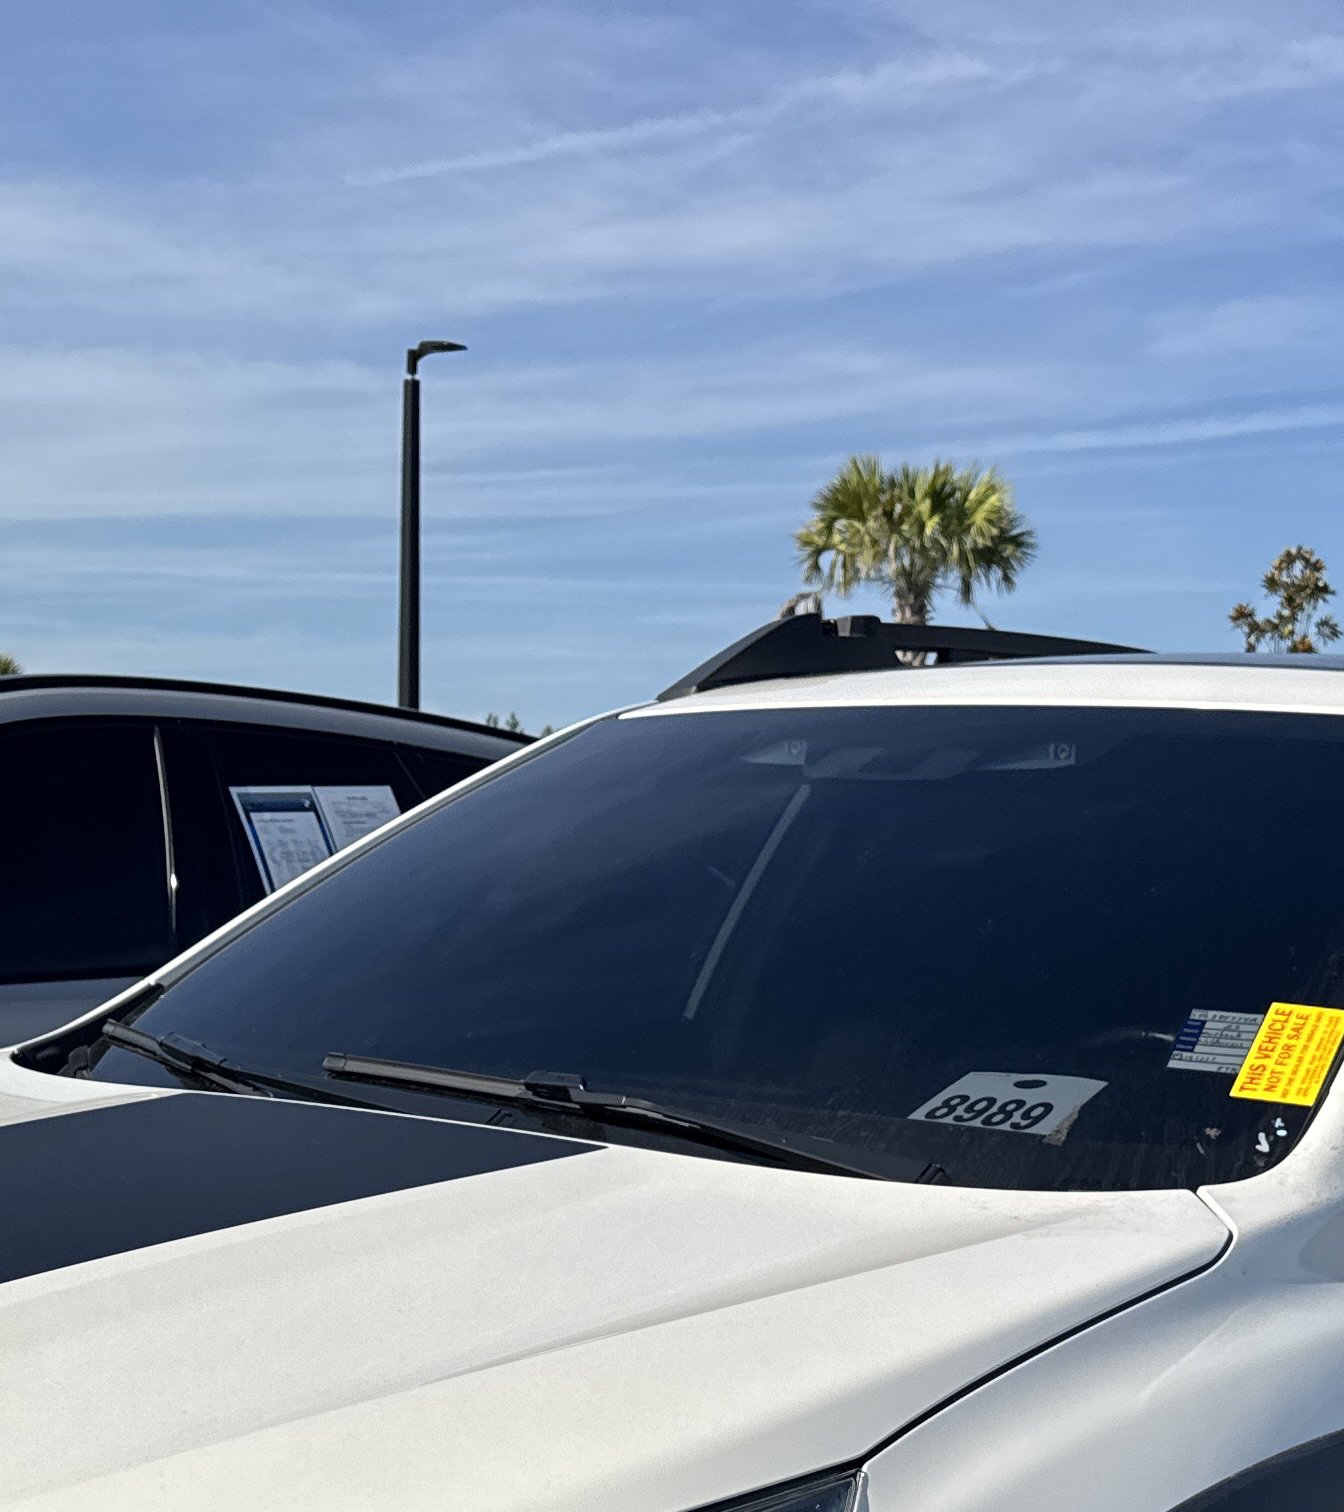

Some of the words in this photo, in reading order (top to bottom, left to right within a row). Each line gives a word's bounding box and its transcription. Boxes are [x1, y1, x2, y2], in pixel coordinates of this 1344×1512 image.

[1239, 1063, 1267, 1093] THIS
[1254, 1008, 1293, 1060] VEHICLE
[1263, 1069, 1285, 1093] NOT
[1274, 1043, 1297, 1067] FOR
[1287, 1012, 1310, 1041] SALE
[924, 1094, 1054, 1131] 8989
